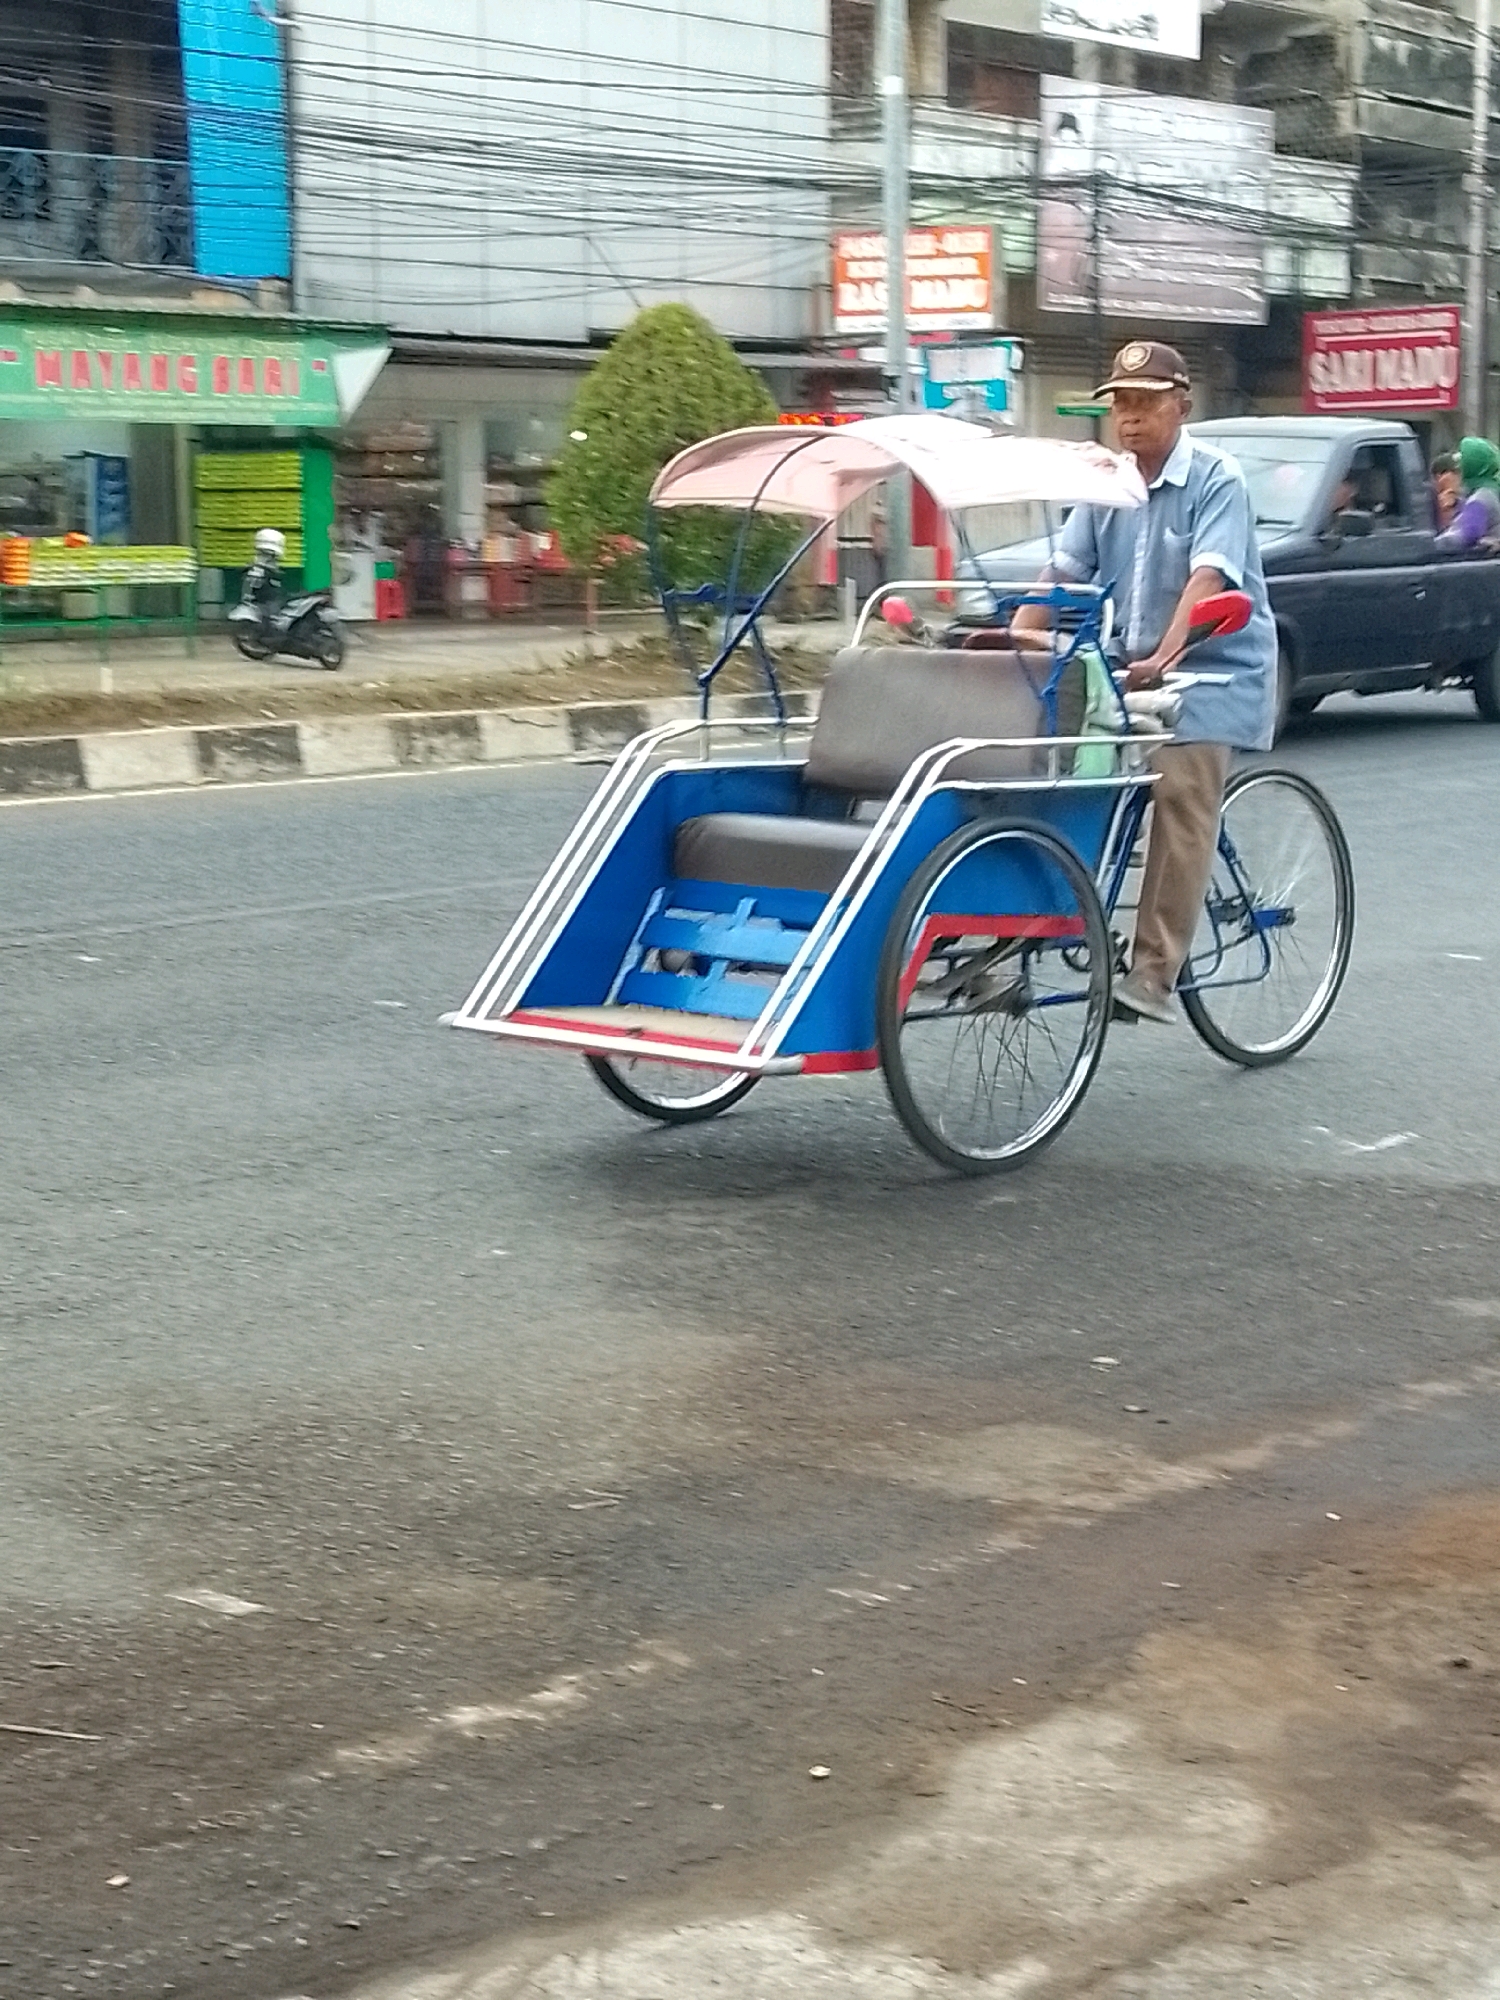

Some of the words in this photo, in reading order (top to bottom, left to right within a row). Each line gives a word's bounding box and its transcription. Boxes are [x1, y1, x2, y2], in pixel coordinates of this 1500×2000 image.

[34, 348, 198, 395] MAYANG
[211, 353, 301, 398] SARI
[1309, 350, 1374, 394] SARI
[1375, 344, 1459, 390] MADU
